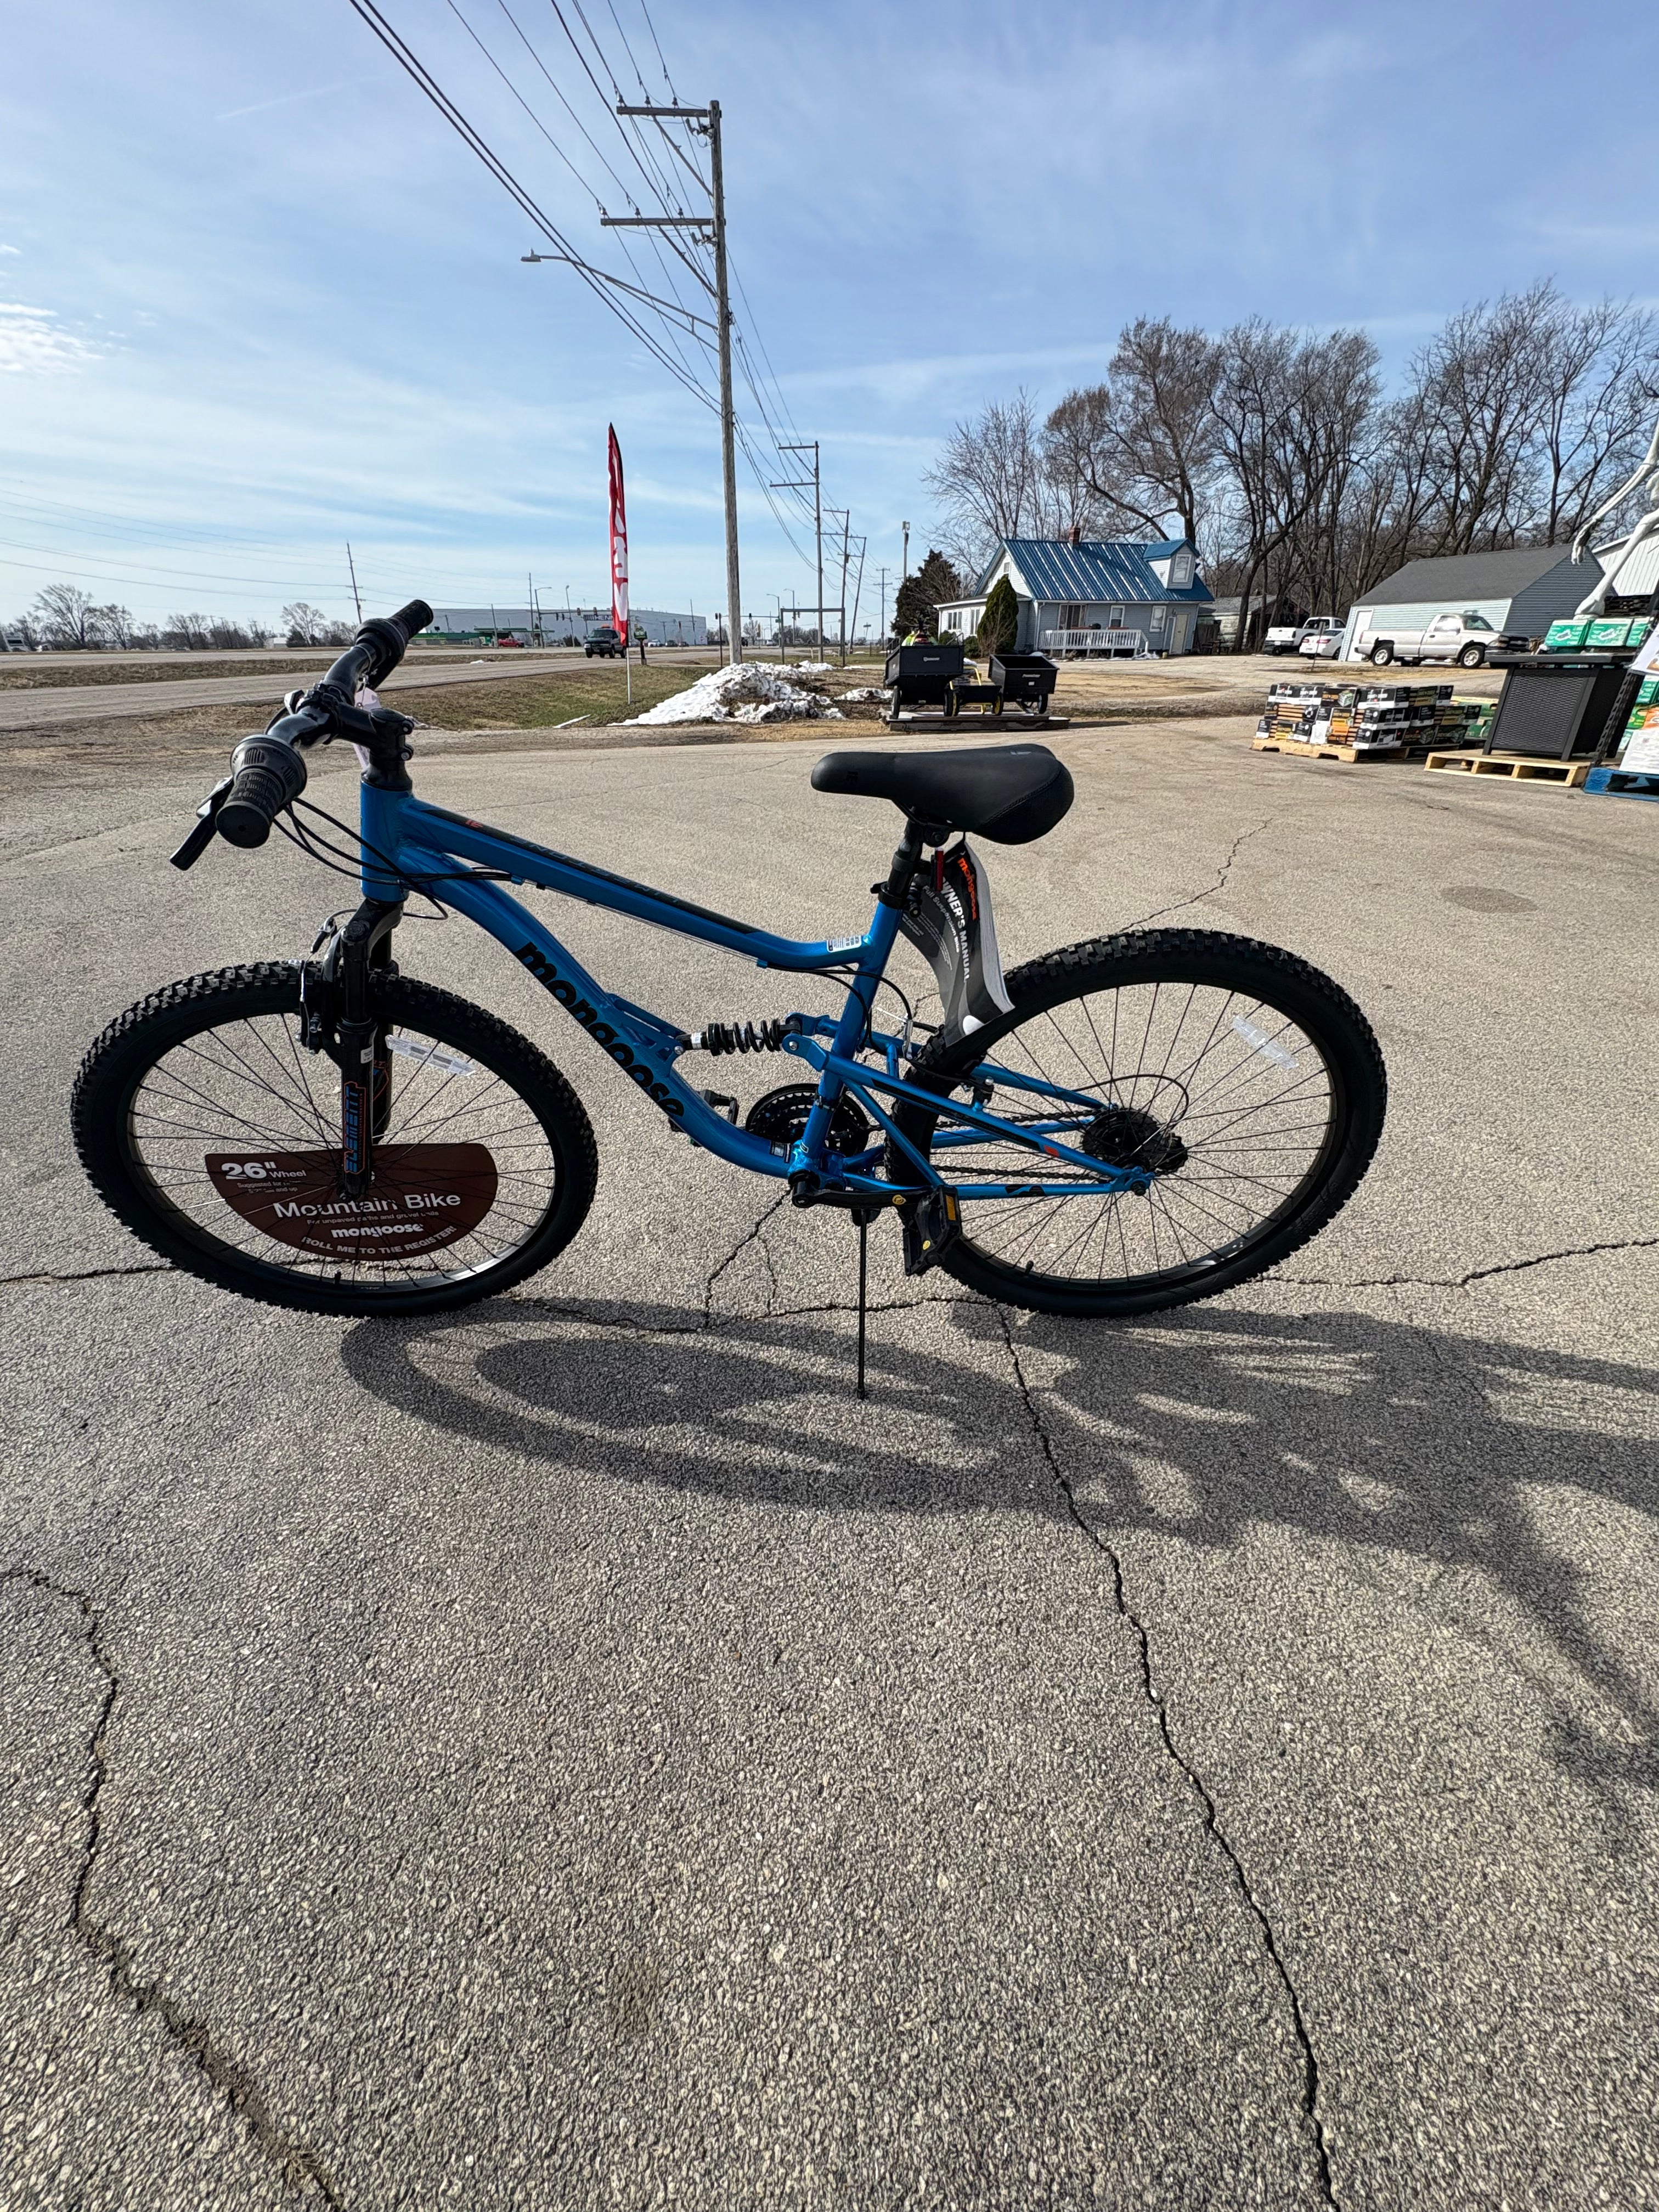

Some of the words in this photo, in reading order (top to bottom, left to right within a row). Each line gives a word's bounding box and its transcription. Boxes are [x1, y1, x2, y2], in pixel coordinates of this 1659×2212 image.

[510, 836, 679, 903] LIMESTONE
[922, 885, 935, 898] Full
[960, 930, 969, 983] MANUAL
[514, 941, 685, 1117] mongoose
[346, 1086, 358, 1173] ELEMENT
[221, 1161, 276, 1180] 26"
[269, 1170, 307, 1178] Wheel
[273, 1198, 398, 1218] Mountain
[404, 1193, 461, 1209] Bike
[301, 1236, 334, 1251] ROLL
[336, 1245, 356, 1254] ME
[378, 1246, 403, 1254] THE
[404, 1226, 457, 1251] REGISTER!
[330, 1223, 424, 1238] mongoose
